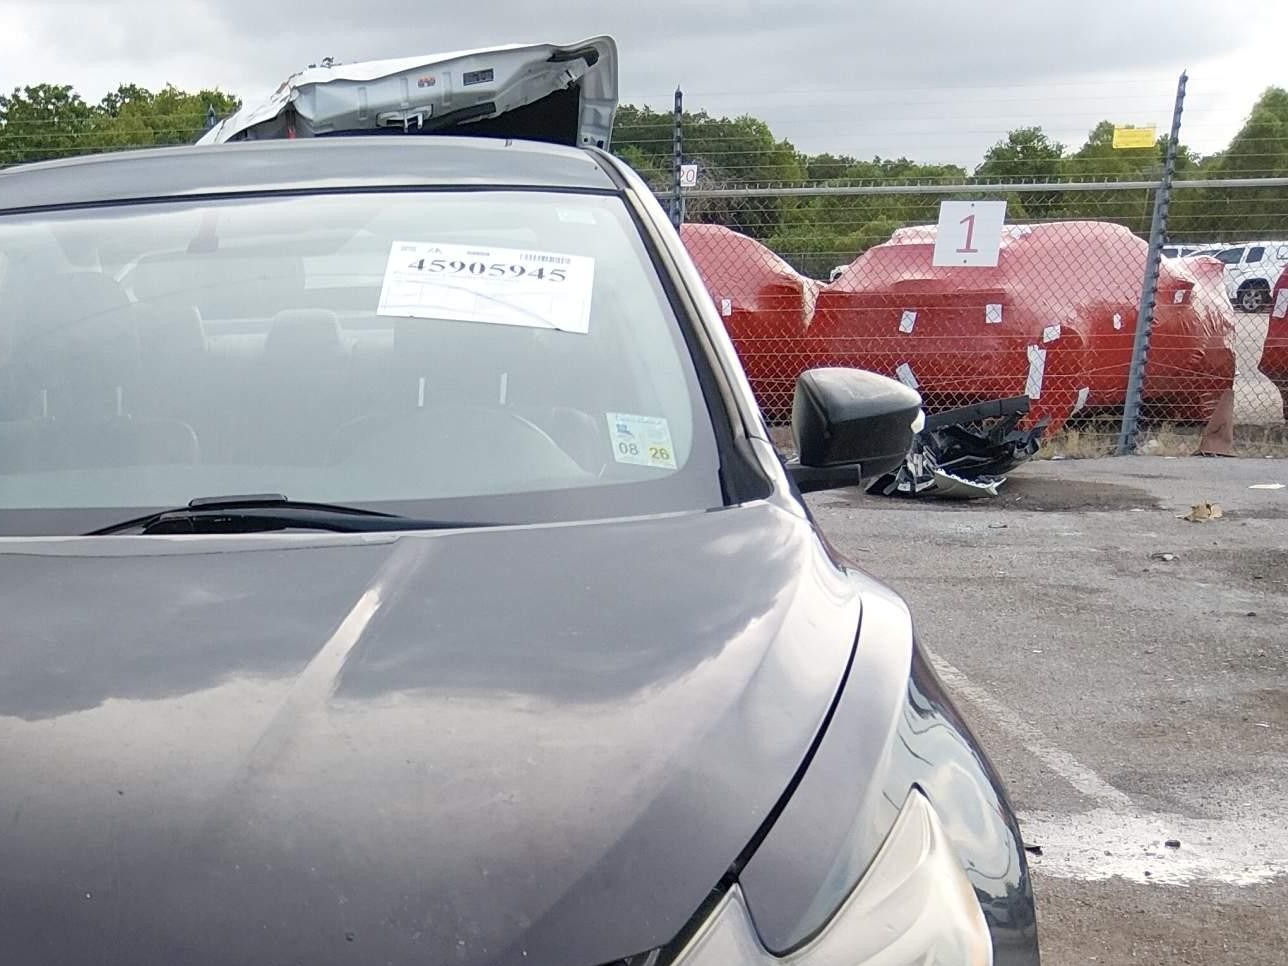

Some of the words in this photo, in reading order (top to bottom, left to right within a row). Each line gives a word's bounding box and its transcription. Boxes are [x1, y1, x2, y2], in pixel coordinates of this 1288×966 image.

[956, 214, 979, 254] 1
[407, 258, 568, 282] 45905945
[618, 441, 639, 456] 08
